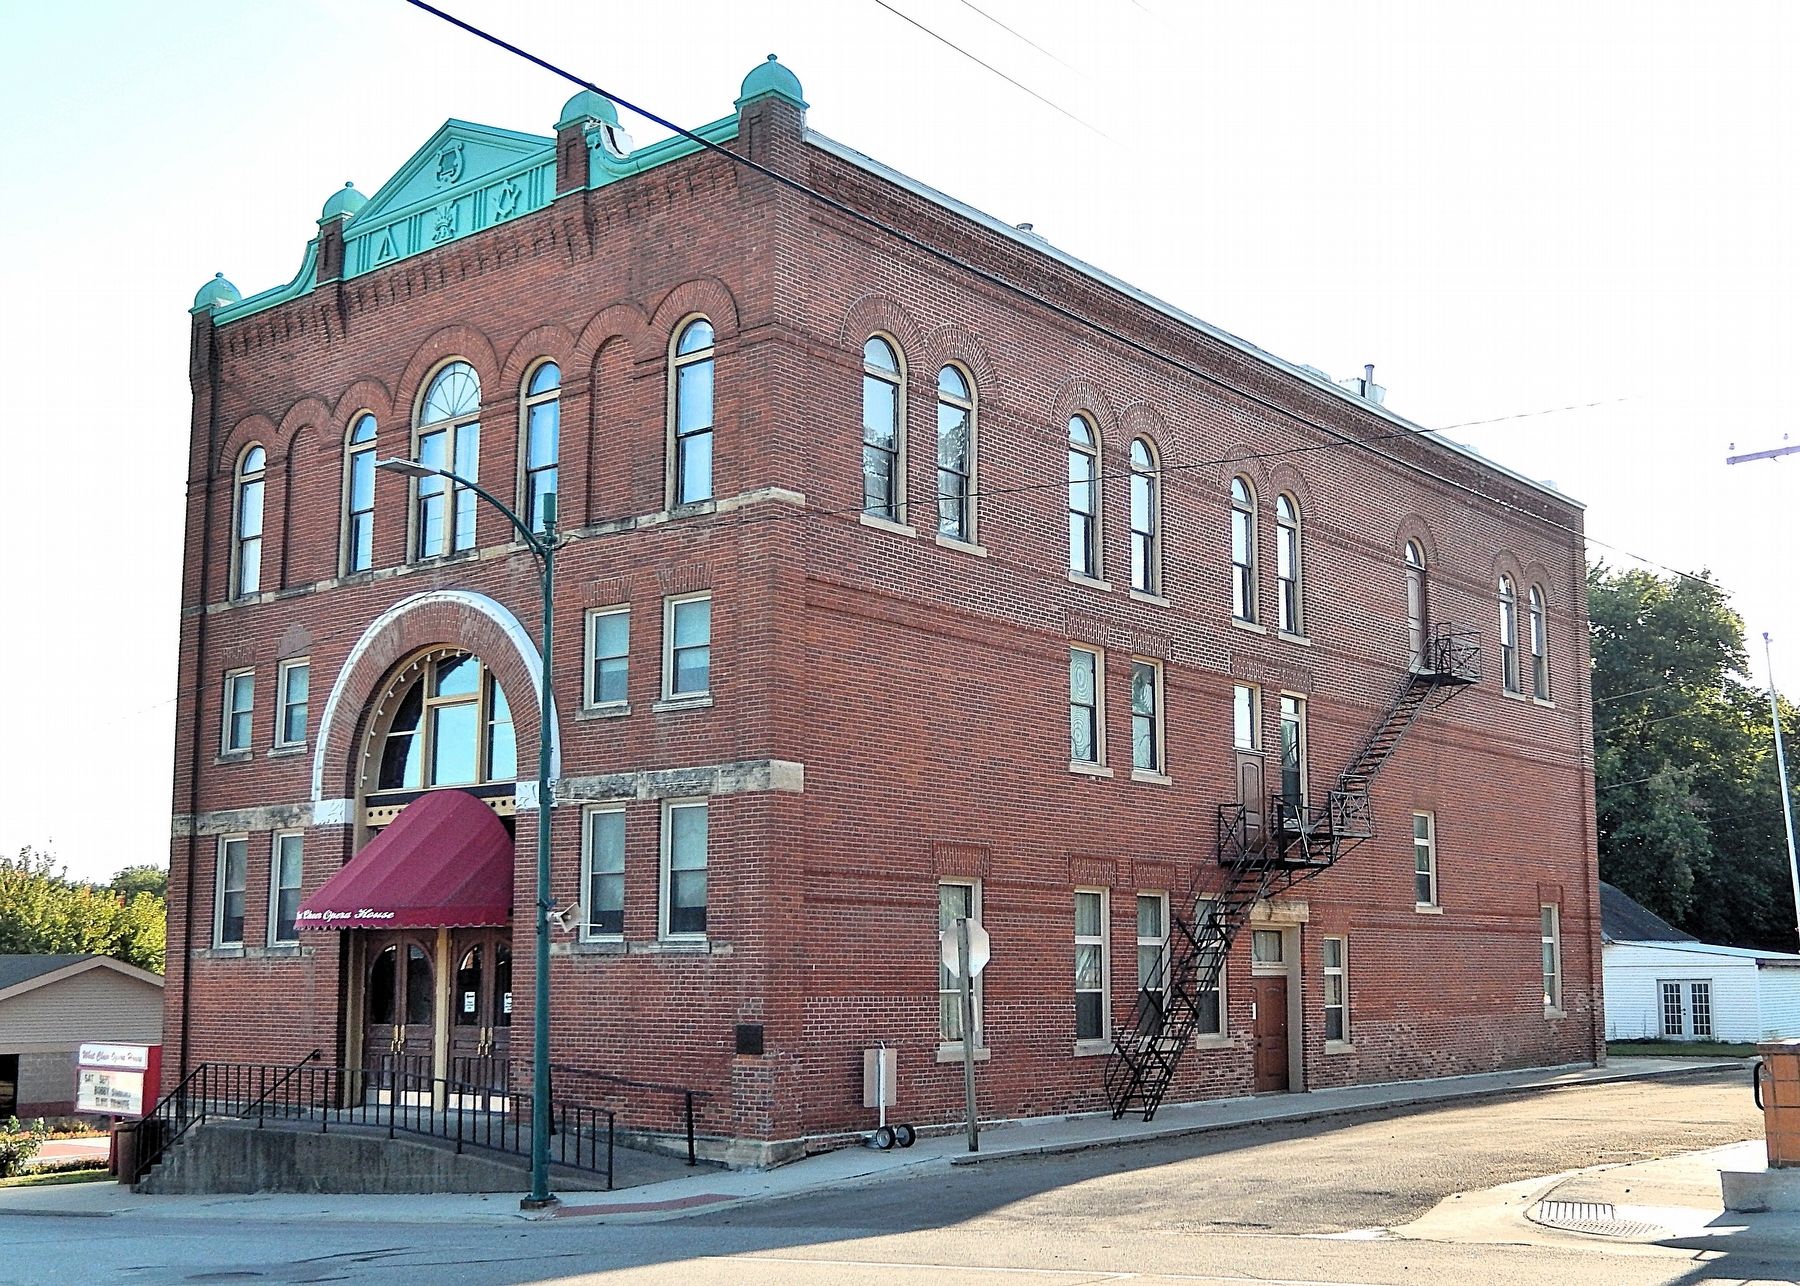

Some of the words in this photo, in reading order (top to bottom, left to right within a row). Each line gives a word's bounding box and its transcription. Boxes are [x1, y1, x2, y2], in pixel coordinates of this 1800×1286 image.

[323, 909, 352, 922] Opera
[354, 908, 395, 919] House
[85, 1074, 94, 1083] SAT
